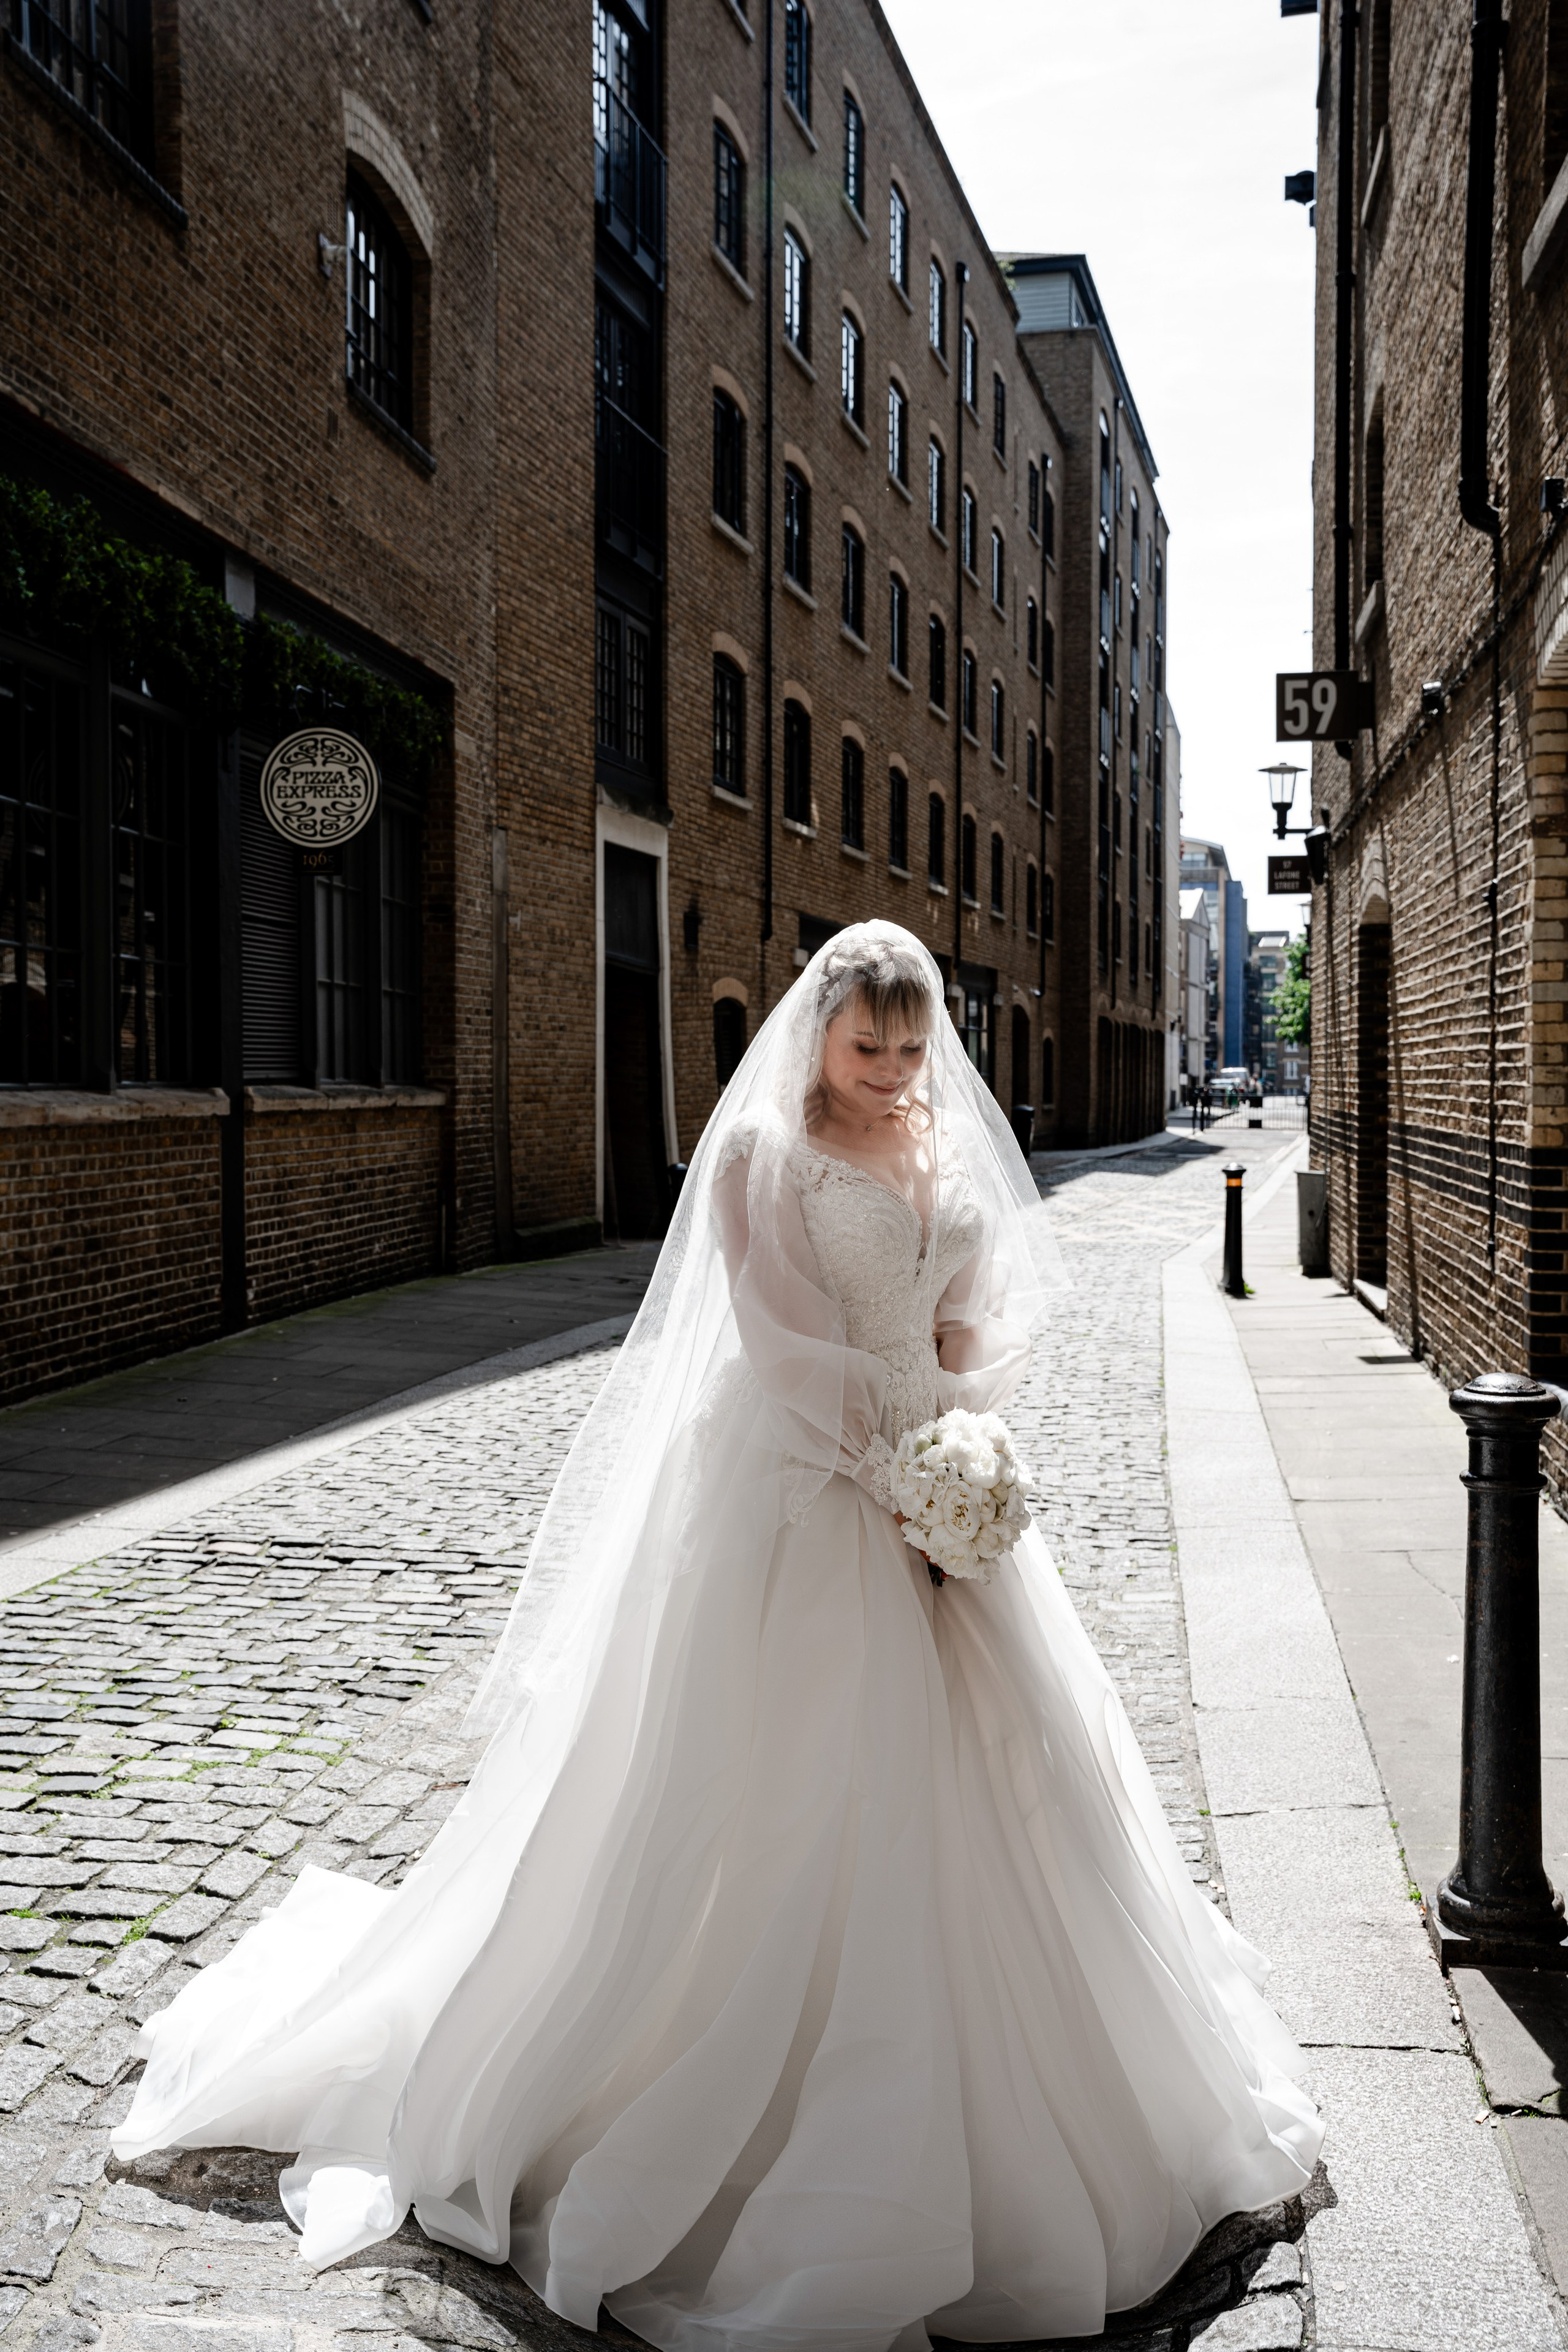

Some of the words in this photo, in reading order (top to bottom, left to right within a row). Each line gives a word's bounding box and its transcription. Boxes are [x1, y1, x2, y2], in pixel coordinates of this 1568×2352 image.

[1284, 679, 1336, 735] 59
[293, 771, 345, 784] PIZZA
[277, 785, 361, 799] EXPRESS
[303, 850, 335, 867] 1965
[1274, 881, 1299, 890] STREET
